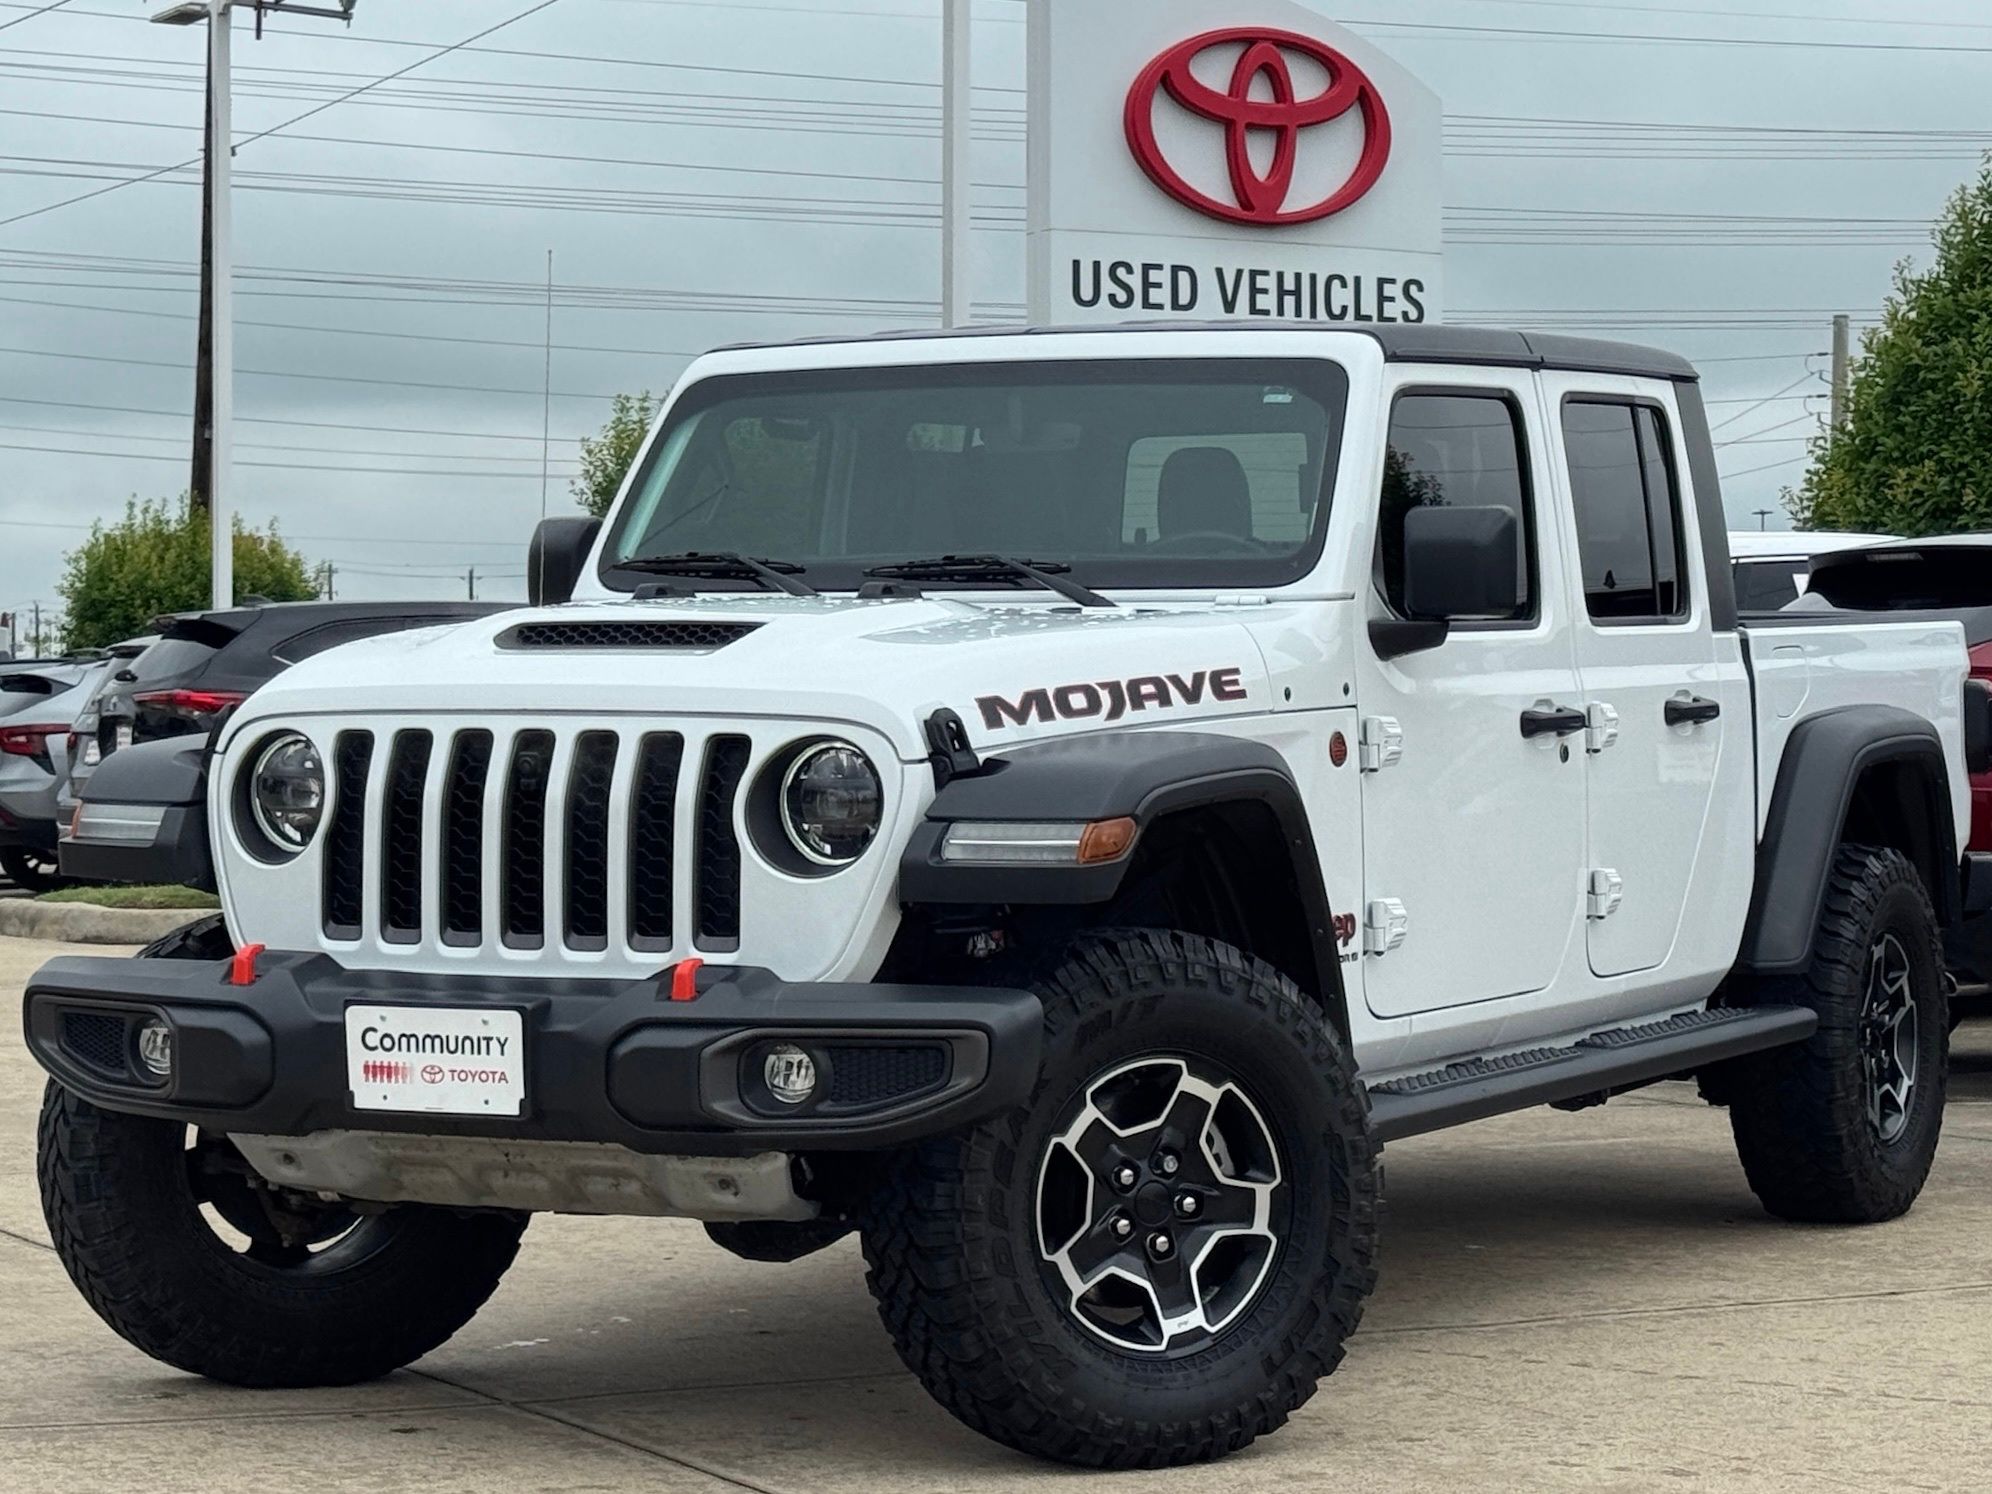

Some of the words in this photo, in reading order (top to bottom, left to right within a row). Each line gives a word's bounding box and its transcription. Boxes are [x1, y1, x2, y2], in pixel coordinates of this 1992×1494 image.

[1072, 258, 1198, 312] USED
[1215, 267, 1425, 323] VEHICLES
[974, 667, 1248, 731] MOJAVE
[449, 1069, 508, 1084] TOYOTA
